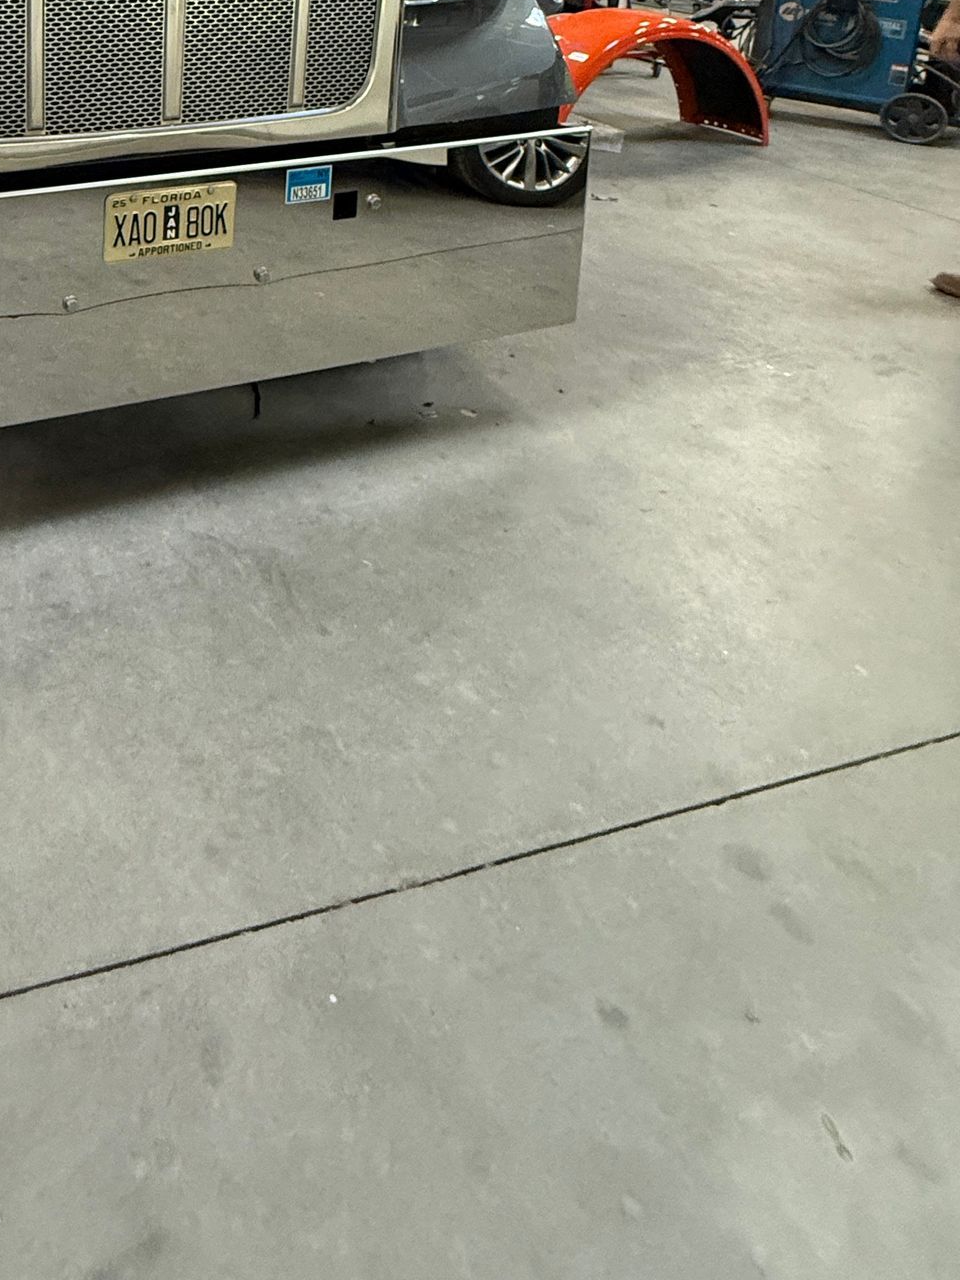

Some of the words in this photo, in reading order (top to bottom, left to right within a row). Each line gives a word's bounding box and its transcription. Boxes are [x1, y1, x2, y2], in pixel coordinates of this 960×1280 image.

[111, 199, 127, 208] 25
[142, 190, 202, 205] FLORIDA
[166, 206, 177, 240] JAN
[138, 240, 202, 257] APPORTIONED
